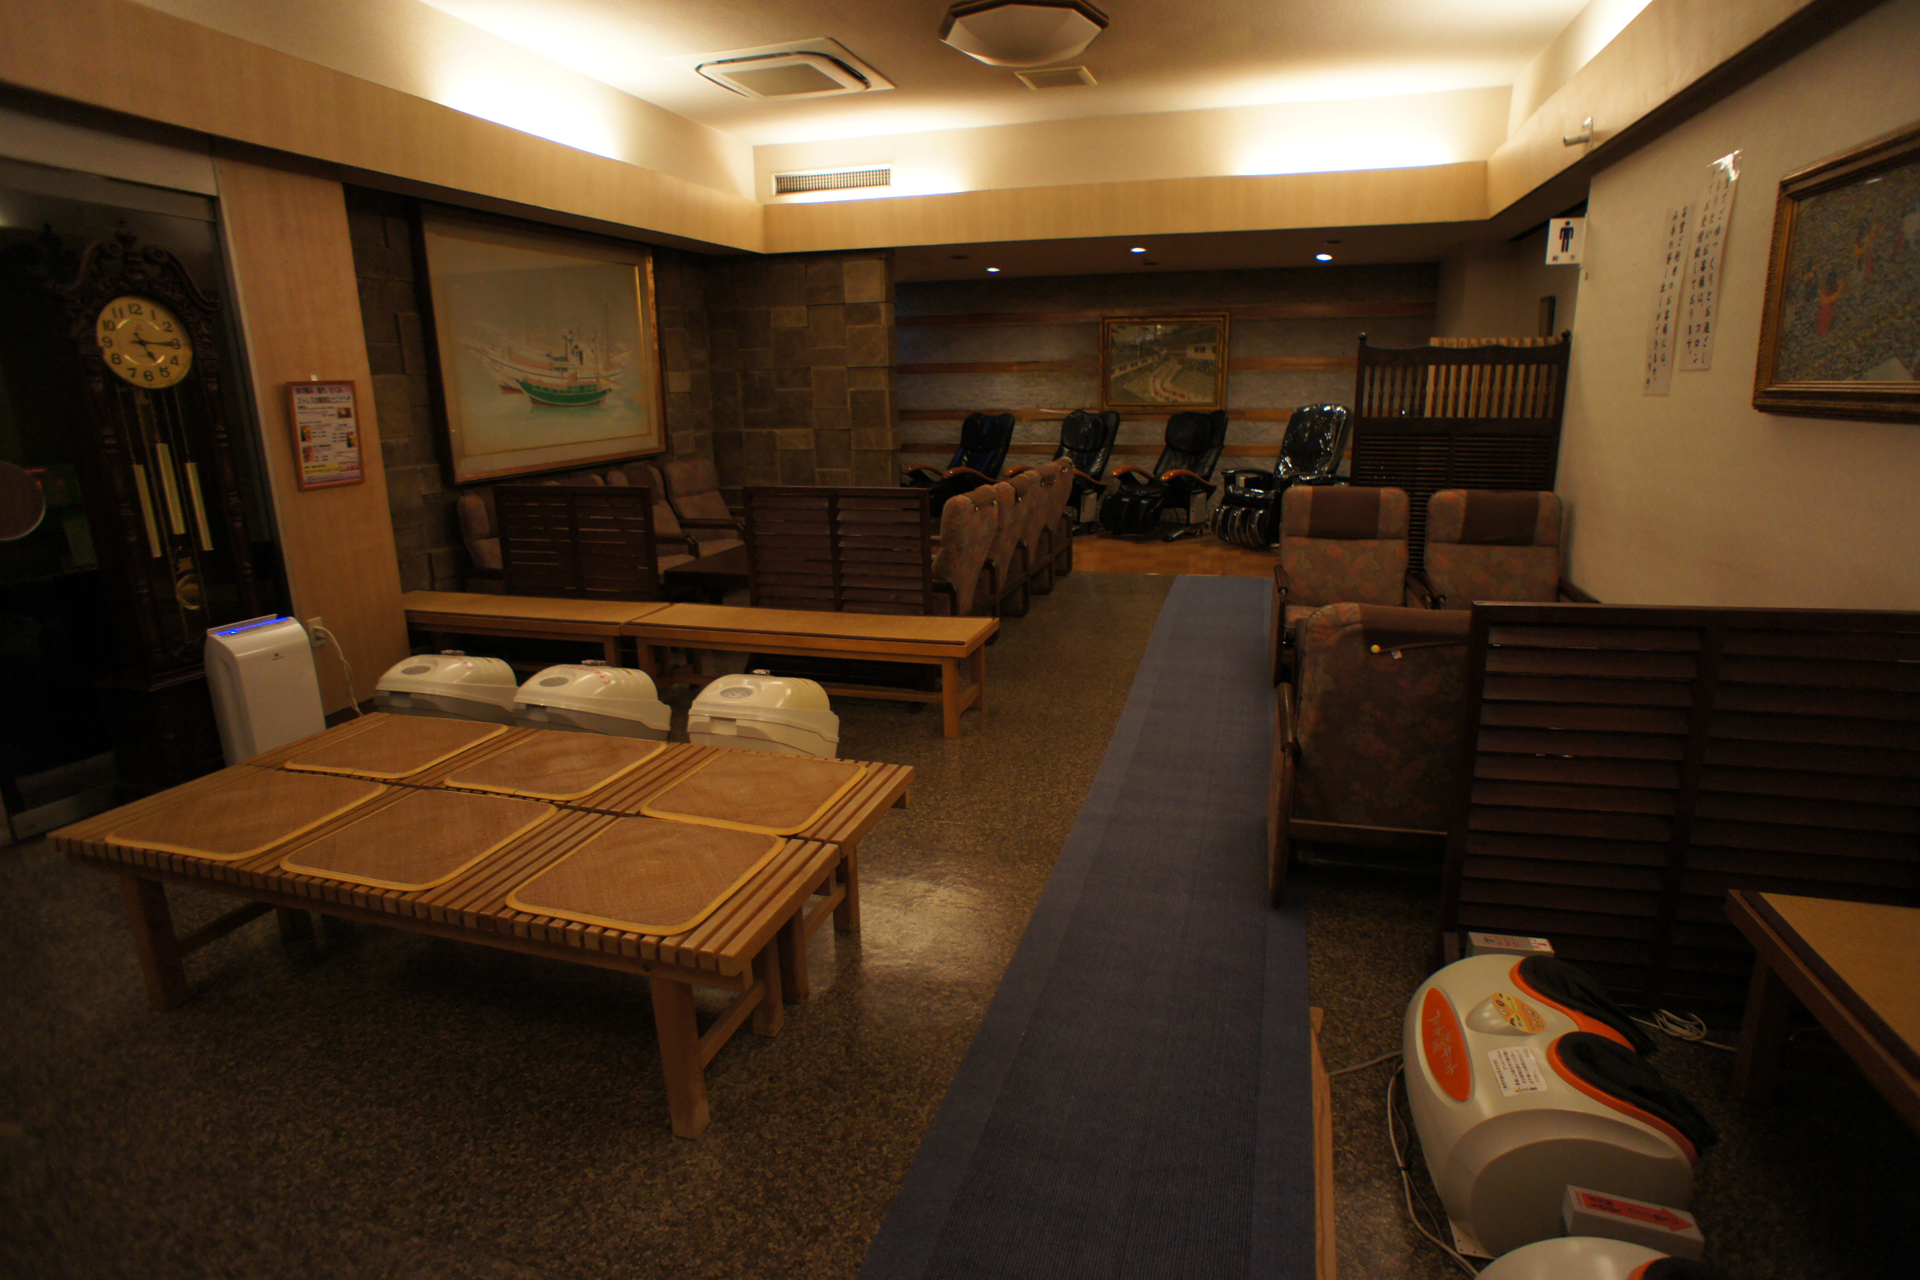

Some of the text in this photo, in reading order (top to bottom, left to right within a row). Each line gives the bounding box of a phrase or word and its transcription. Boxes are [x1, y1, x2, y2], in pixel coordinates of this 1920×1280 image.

[112, 307, 124, 319] 11
[128, 303, 143, 315] 12
[102, 320, 115, 331] 10
[162, 321, 173, 332] 2
[102, 336, 113, 348] 9
[111, 353, 121, 365] 8
[170, 356, 179, 366] 4
[127, 367, 137, 378] 7
[143, 370, 154, 381] 6
[159, 366, 170, 378] 5
